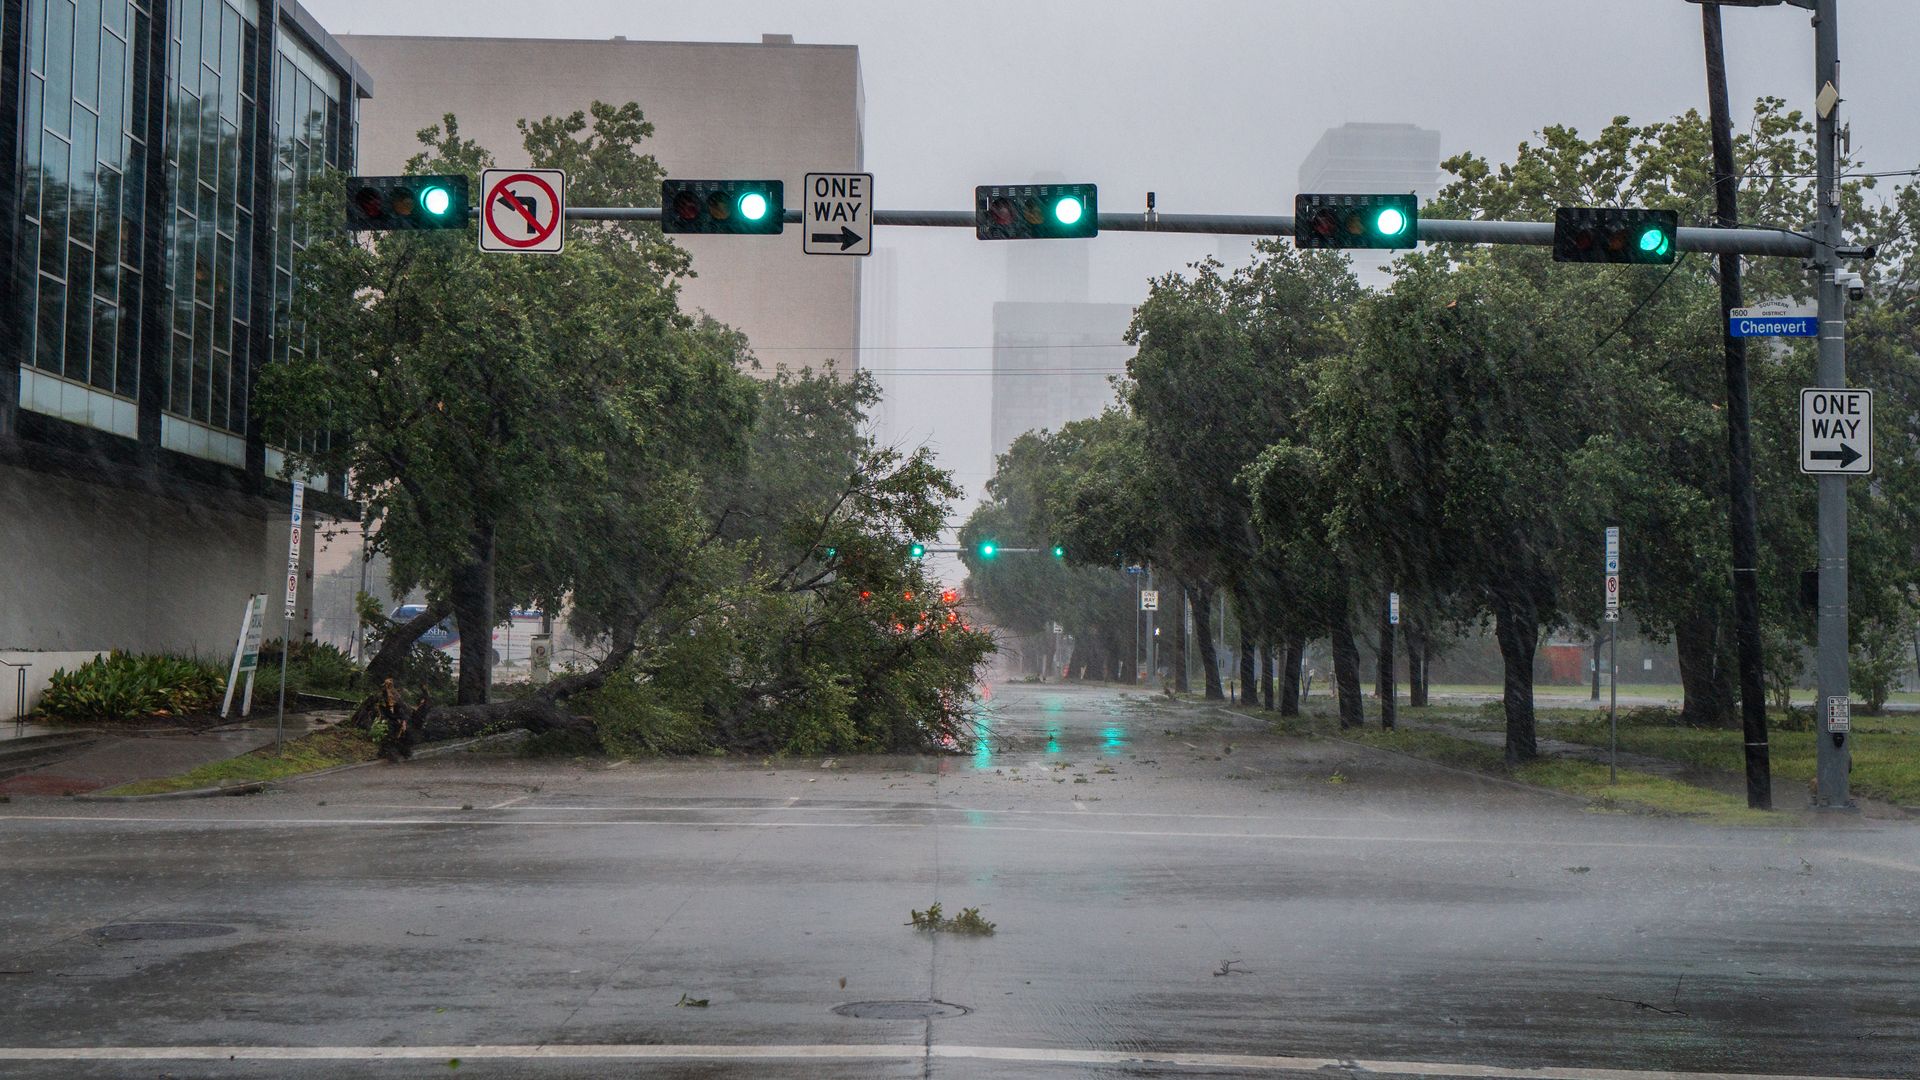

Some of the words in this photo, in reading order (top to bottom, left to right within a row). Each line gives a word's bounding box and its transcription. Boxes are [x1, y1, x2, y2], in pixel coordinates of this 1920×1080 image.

[815, 177, 861, 198] ONE
[814, 202, 862, 222] WAY
[1732, 309, 1748, 317] 1600
[1740, 320, 1807, 334] Chenevert
[1813, 394, 1860, 415] ONE
[1812, 419, 1861, 439] WAY
